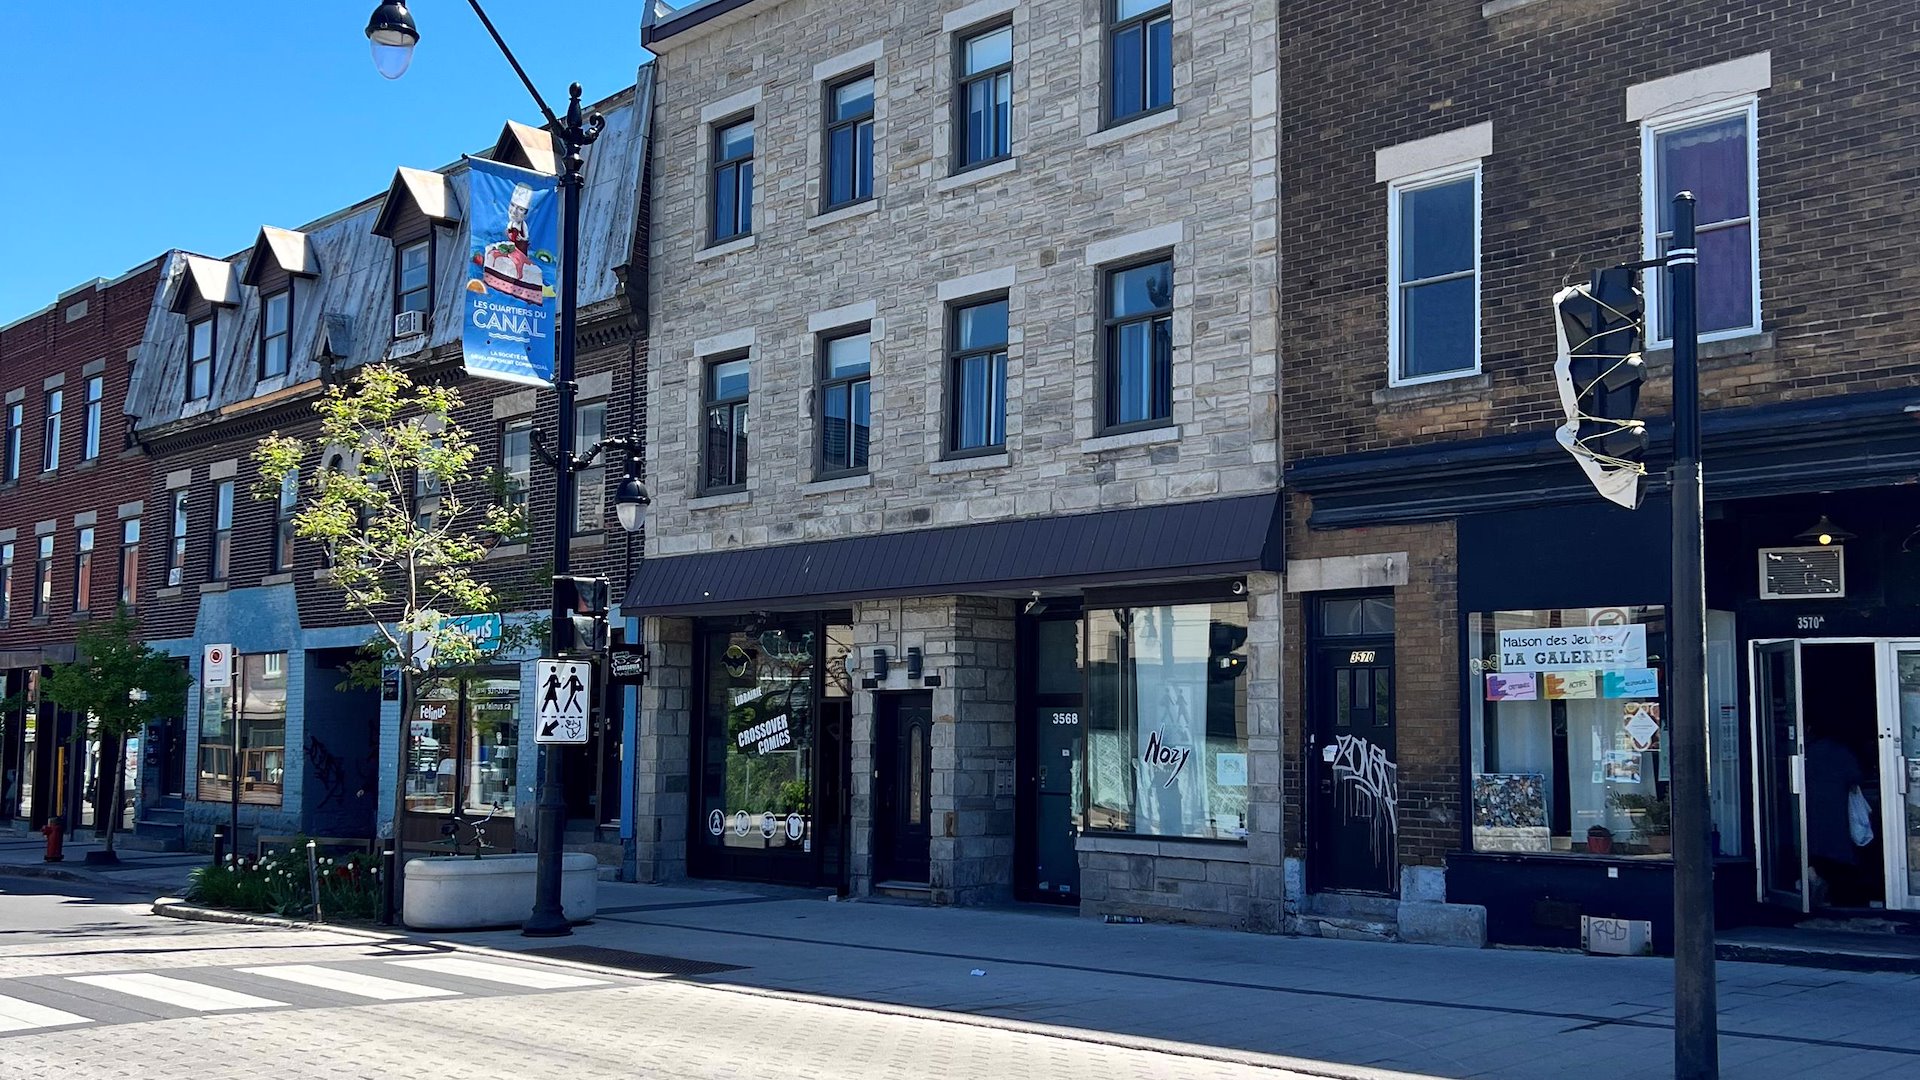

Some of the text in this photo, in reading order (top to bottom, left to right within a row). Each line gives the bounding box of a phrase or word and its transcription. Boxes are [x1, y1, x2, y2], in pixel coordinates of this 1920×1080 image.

[474, 300, 547, 319] LES QUARTIERS DU
[473, 309, 546, 338] CANAL
[1503, 634, 1614, 648] Maison des Jeunes
[1350, 651, 1375, 663] 3570
[1504, 652, 1526, 666] LA
[420, 704, 446, 720] Felinus
[1052, 713, 1078, 724] 3568
[738, 714, 788, 747] CROSSOVER
[758, 729, 790, 755] COMICS
[1144, 724, 1191, 789] Nozy
